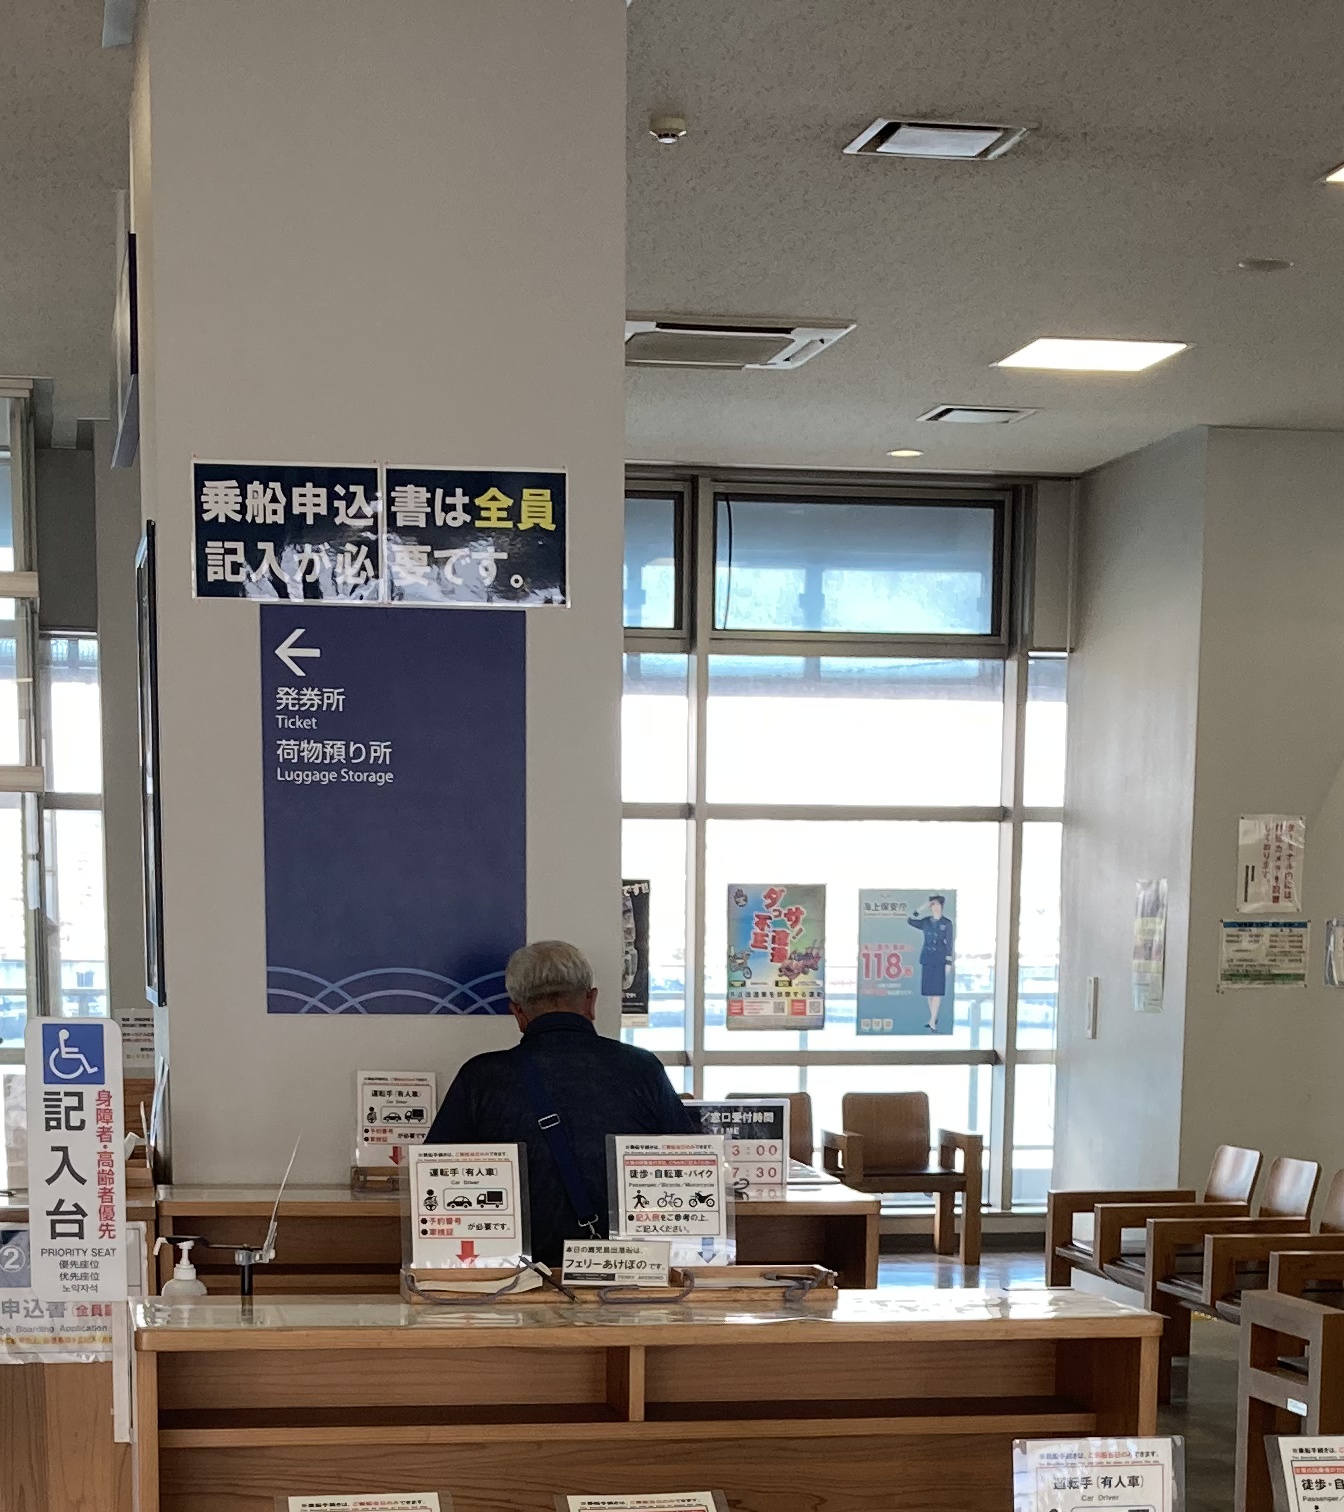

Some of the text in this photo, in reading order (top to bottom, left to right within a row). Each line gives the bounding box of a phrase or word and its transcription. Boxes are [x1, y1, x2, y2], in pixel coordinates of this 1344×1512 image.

[200, 478, 556, 531] 乗船申込書は全員
[205, 540, 524, 591] 記入が必要です。
[275, 687, 346, 712] 発券所
[276, 714, 318, 730] Ticket
[276, 739, 392, 765] 荷物預り所
[276, 767, 394, 785] Luggage Storage
[42, 1090, 88, 1241] 記入台
[95, 1089, 117, 1240] 身障者・高齢者優先
[40, 1248, 117, 1257] PRIORITY SEAT
[62, 1284, 98, 1293] 노약자석
[1081, 1494, 1095, 1502] Car
